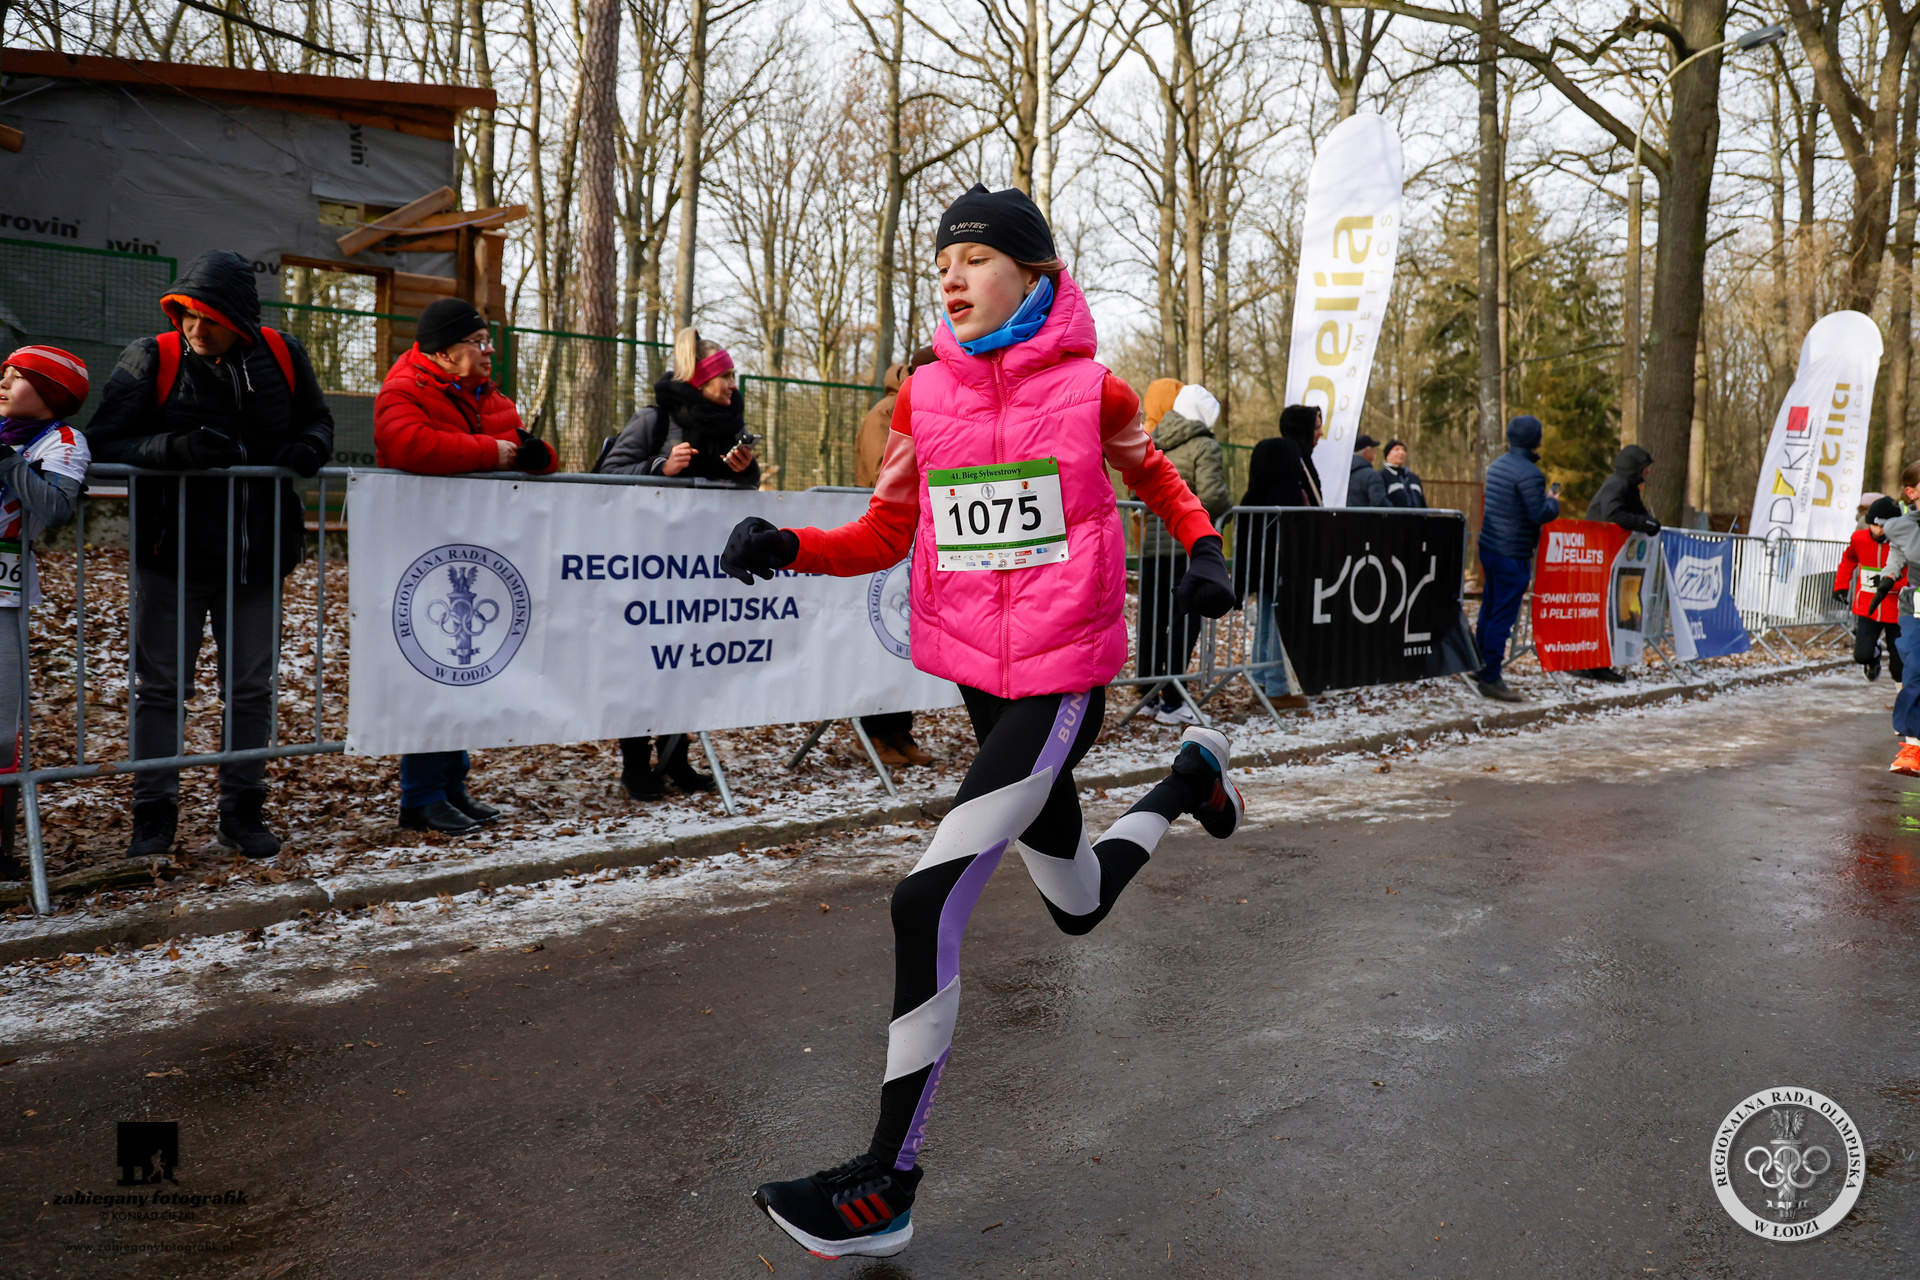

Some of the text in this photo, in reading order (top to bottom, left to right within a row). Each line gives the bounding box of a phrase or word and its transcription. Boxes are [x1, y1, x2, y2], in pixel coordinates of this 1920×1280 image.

[962, 470, 978, 480] Bieg
[979, 467, 1022, 478] Sylwestrowy
[949, 495, 1042, 536] 1075
[397, 554, 443, 638] REGIONALNA
[448, 549, 488, 564] RADA
[624, 596, 800, 626] OLIMPIJSKA
[651, 638, 773, 670] W ŁODZI
[434, 666, 449, 679] W
